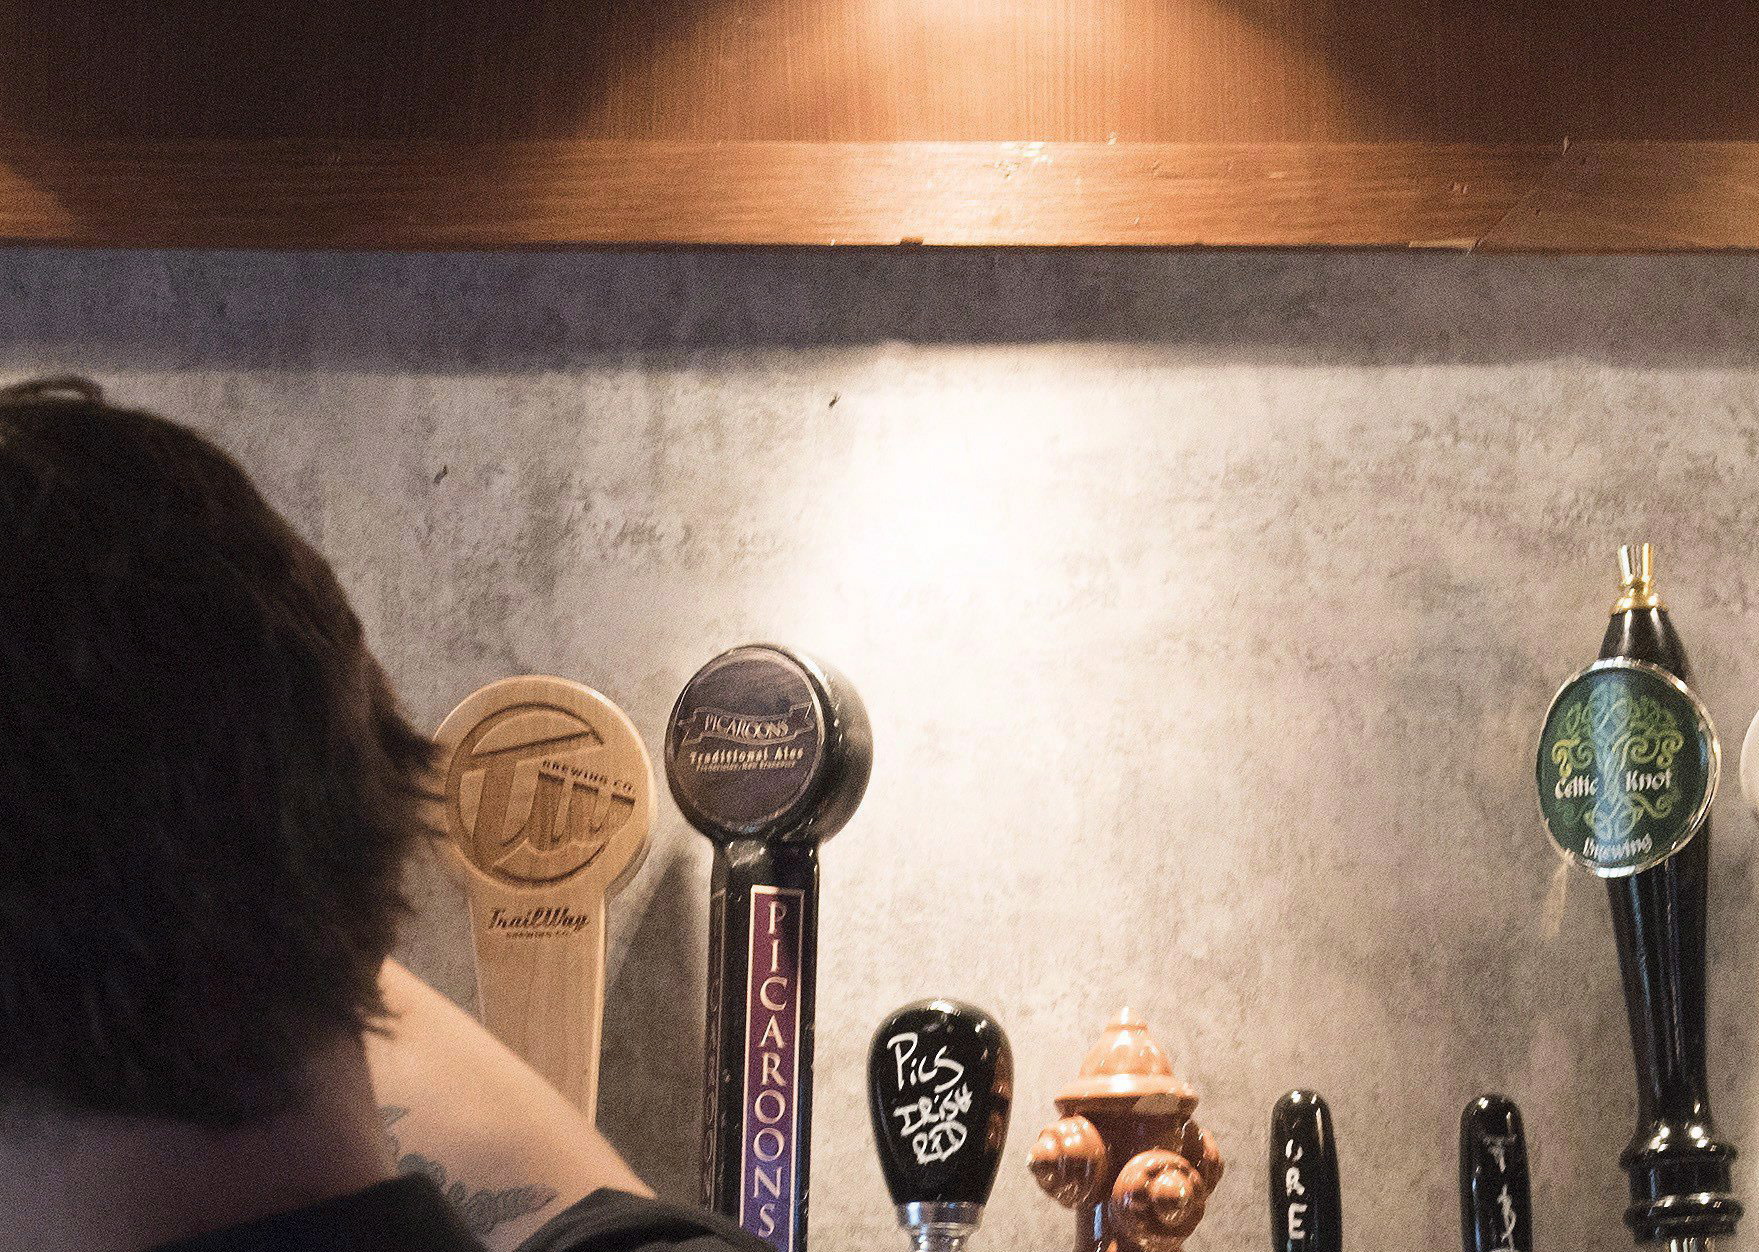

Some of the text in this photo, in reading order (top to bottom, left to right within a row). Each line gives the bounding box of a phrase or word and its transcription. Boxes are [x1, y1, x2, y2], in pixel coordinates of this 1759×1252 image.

[704, 714, 789, 739] PICAROONS
[690, 746, 804, 765] Traditional Ales
[1555, 769, 1673, 800] Celtic Knot
[1582, 833, 1654, 860] Brewing
[752, 900, 789, 1239] PICAROONS
